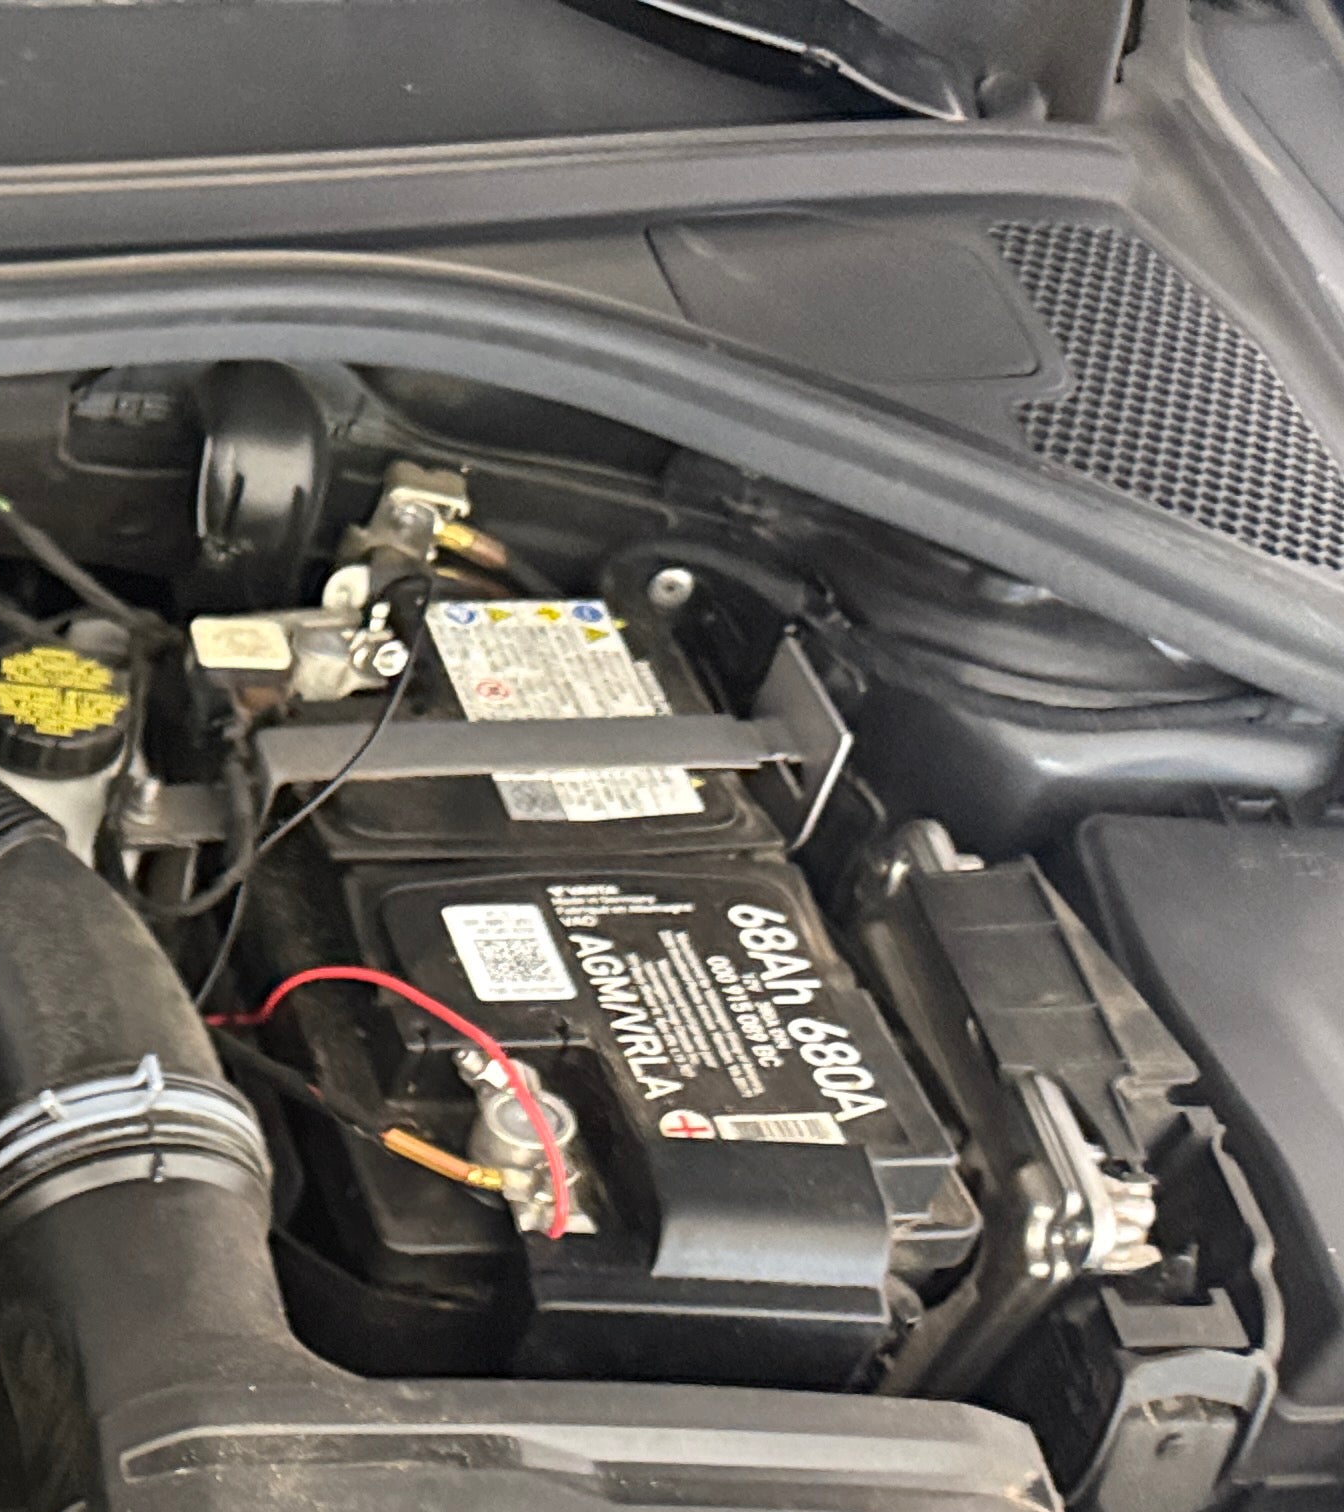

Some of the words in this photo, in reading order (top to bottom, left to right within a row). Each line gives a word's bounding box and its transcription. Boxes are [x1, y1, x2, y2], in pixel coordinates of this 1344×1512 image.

[567, 932, 685, 1100] AGM/VRLA
[727, 904, 823, 1006] 68Ah
[787, 1017, 888, 1122] 680A
